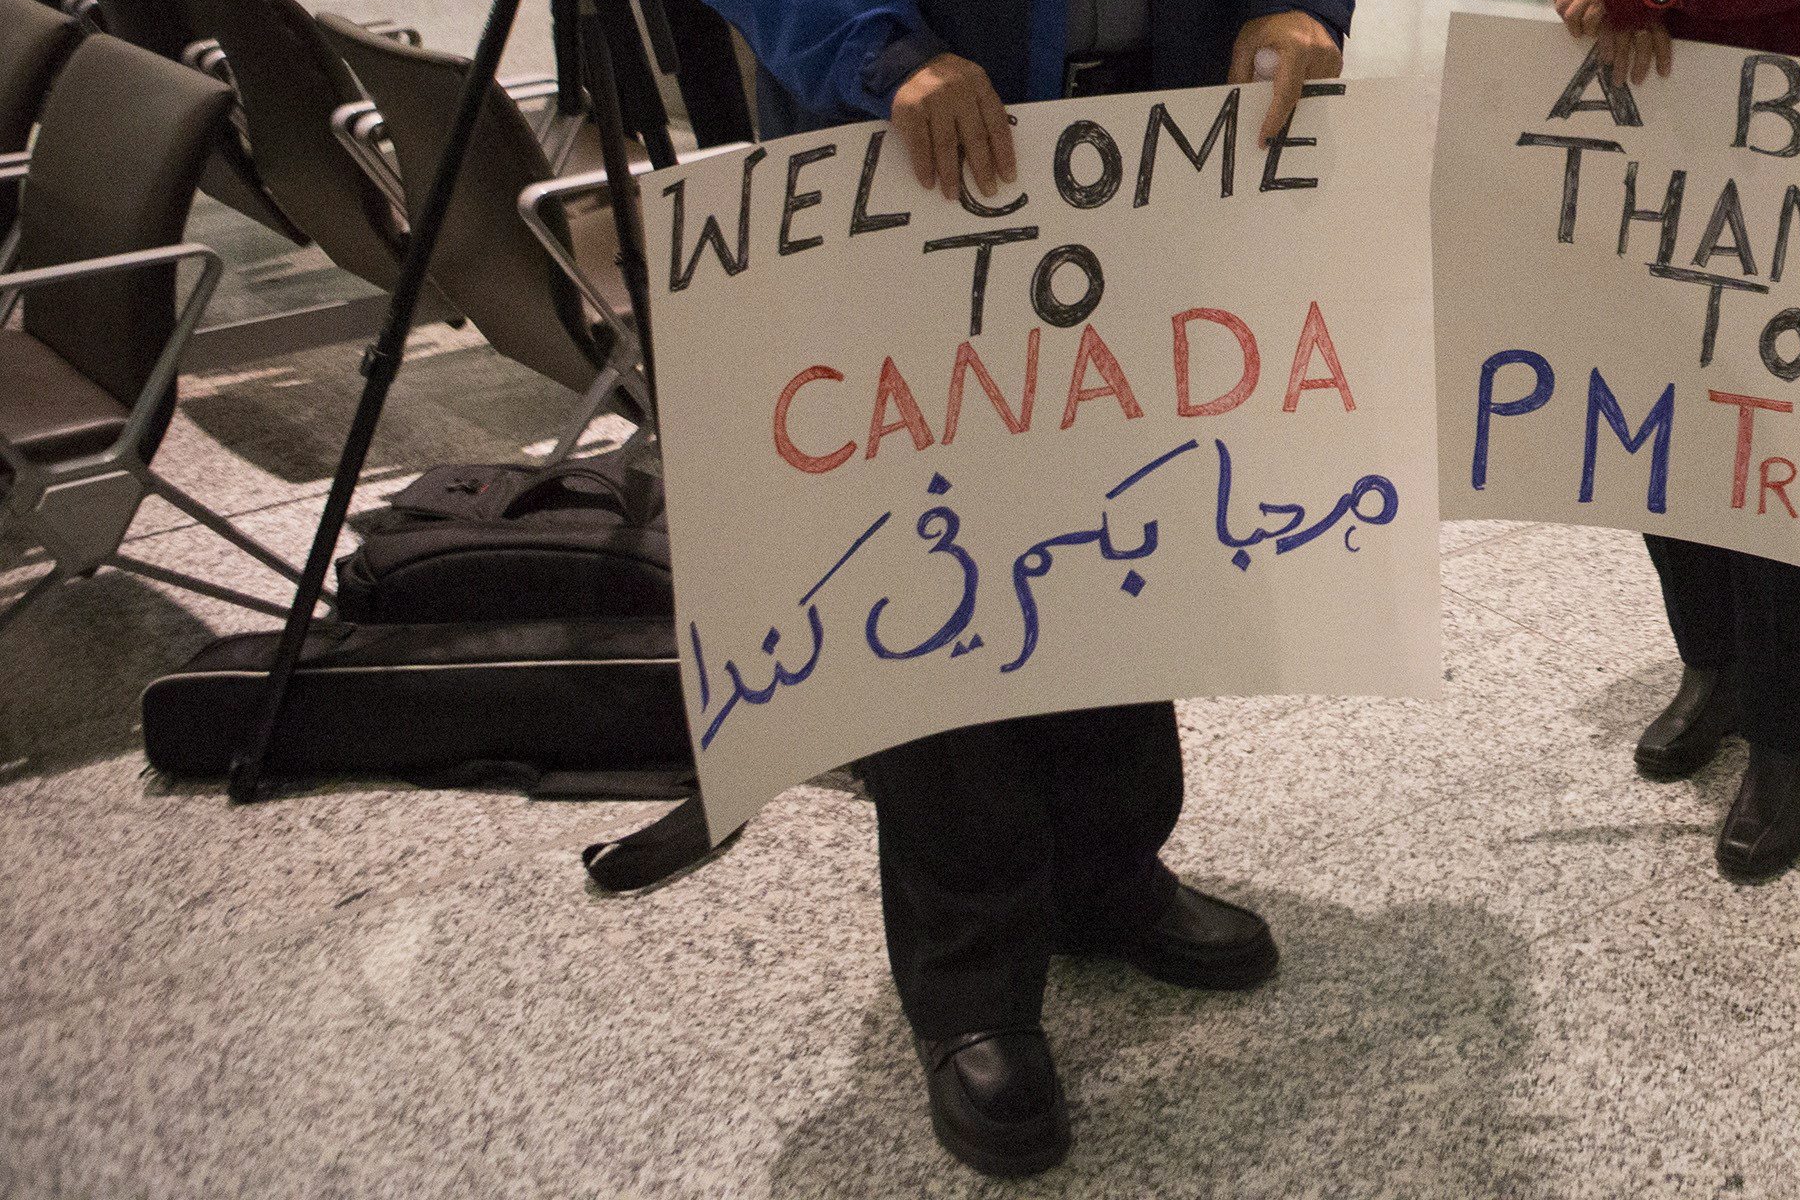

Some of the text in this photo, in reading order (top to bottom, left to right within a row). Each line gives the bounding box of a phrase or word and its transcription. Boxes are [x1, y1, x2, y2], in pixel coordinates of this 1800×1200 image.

[1546, 43, 1645, 128] A
[923, 225, 1105, 337] TO
[773, 300, 1359, 475] CANADA
[1471, 348, 1676, 515] PM
[690, 511, 893, 751] كندا
